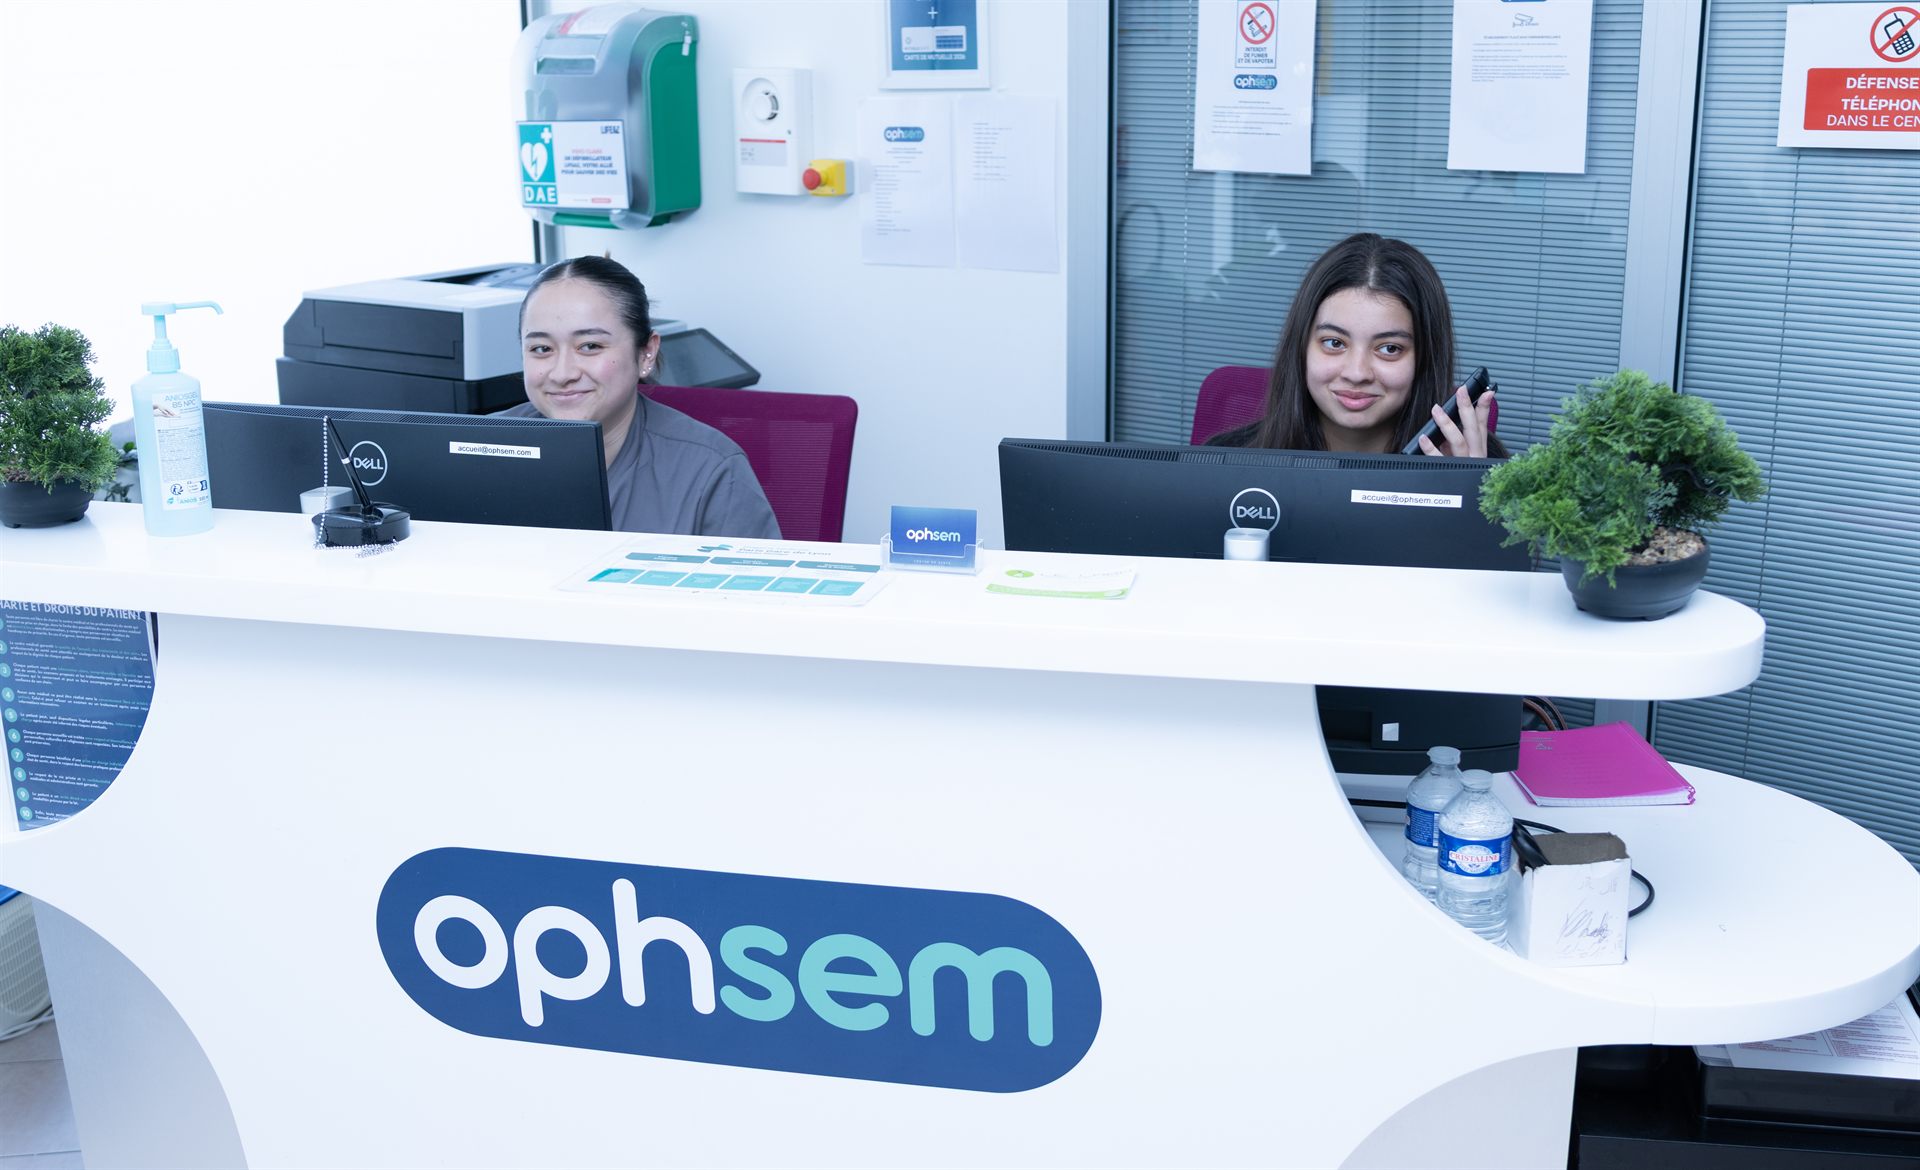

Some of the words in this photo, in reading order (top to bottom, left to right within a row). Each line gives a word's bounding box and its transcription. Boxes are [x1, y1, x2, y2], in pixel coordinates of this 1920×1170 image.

[1846, 73, 1920, 89] DÉFENSE
[1827, 114, 1868, 127] DANS
[1872, 115, 1890, 127] LE
[524, 186, 556, 202] DAE
[457, 446, 532, 456] accueil@ophsem.com
[353, 457, 384, 470] DELL
[1361, 494, 1451, 505] accueil@ophsem.com
[1236, 505, 1275, 519] DELL
[906, 527, 960, 543] ophsem
[44, 603, 81, 615] DROITS
[84, 606, 97, 616] DU
[100, 608, 141, 620] PATIENT
[1450, 852, 1498, 862] CRISTALINE
[414, 878, 1053, 1047] ophsem
